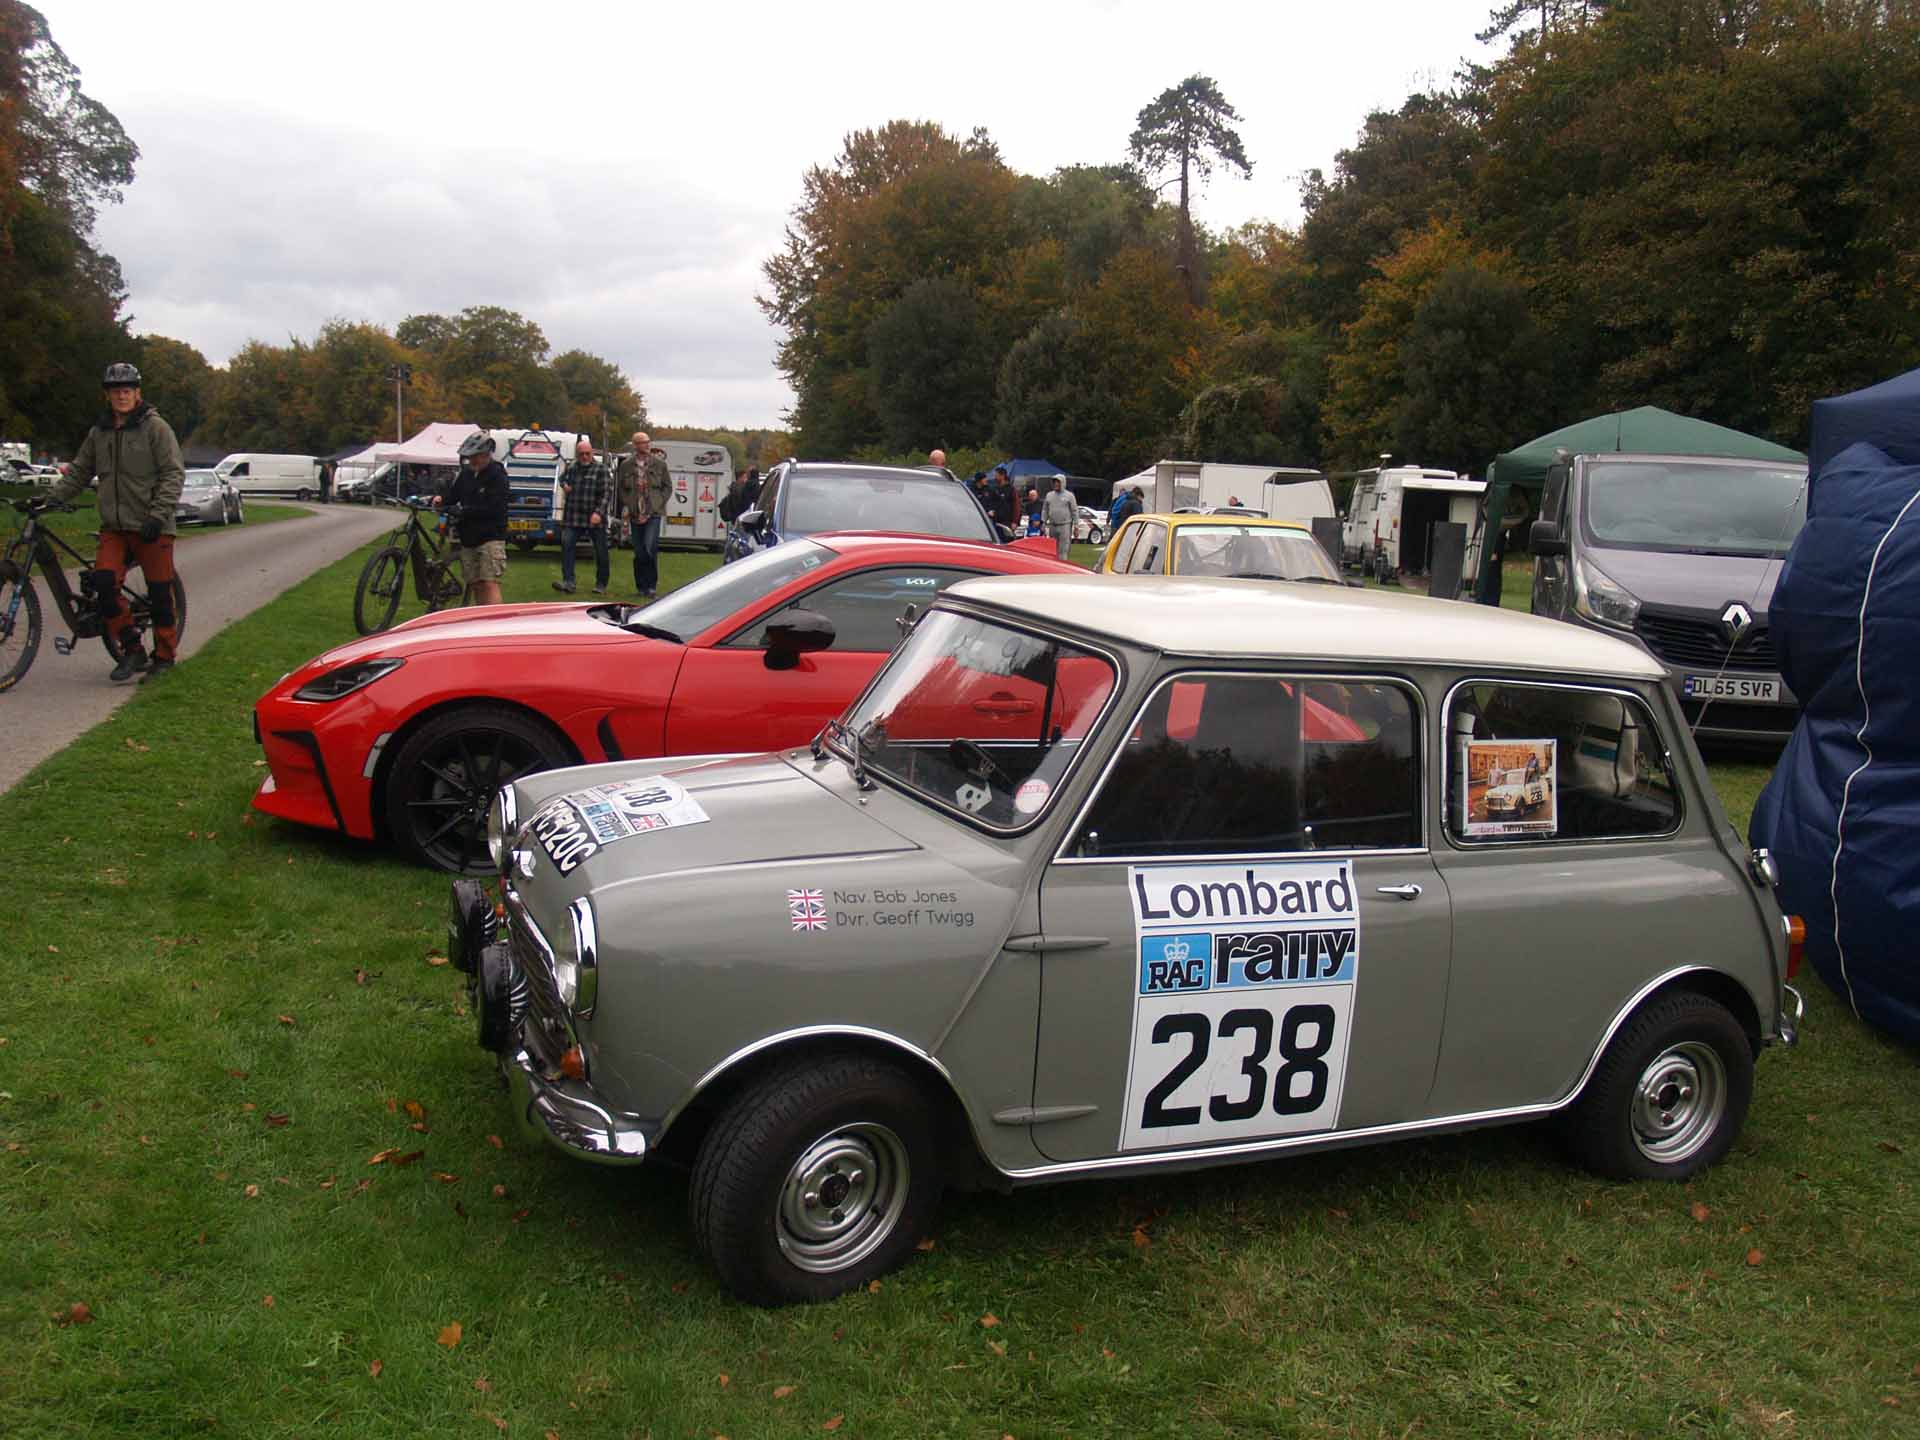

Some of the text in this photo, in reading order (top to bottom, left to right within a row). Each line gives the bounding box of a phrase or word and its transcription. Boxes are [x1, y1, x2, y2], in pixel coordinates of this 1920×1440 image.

[1692, 679, 1773, 697] DL65 SVR
[619, 787, 673, 808] 38
[874, 890, 907, 904] Bob
[913, 889, 958, 904] Jones
[1135, 867, 1353, 920] Lombard
[836, 910, 975, 927] Dvr. Geoff Twigg
[1214, 930, 1355, 985] rally
[1147, 959, 1204, 992] RAC
[1141, 1003, 1336, 1130] 238
